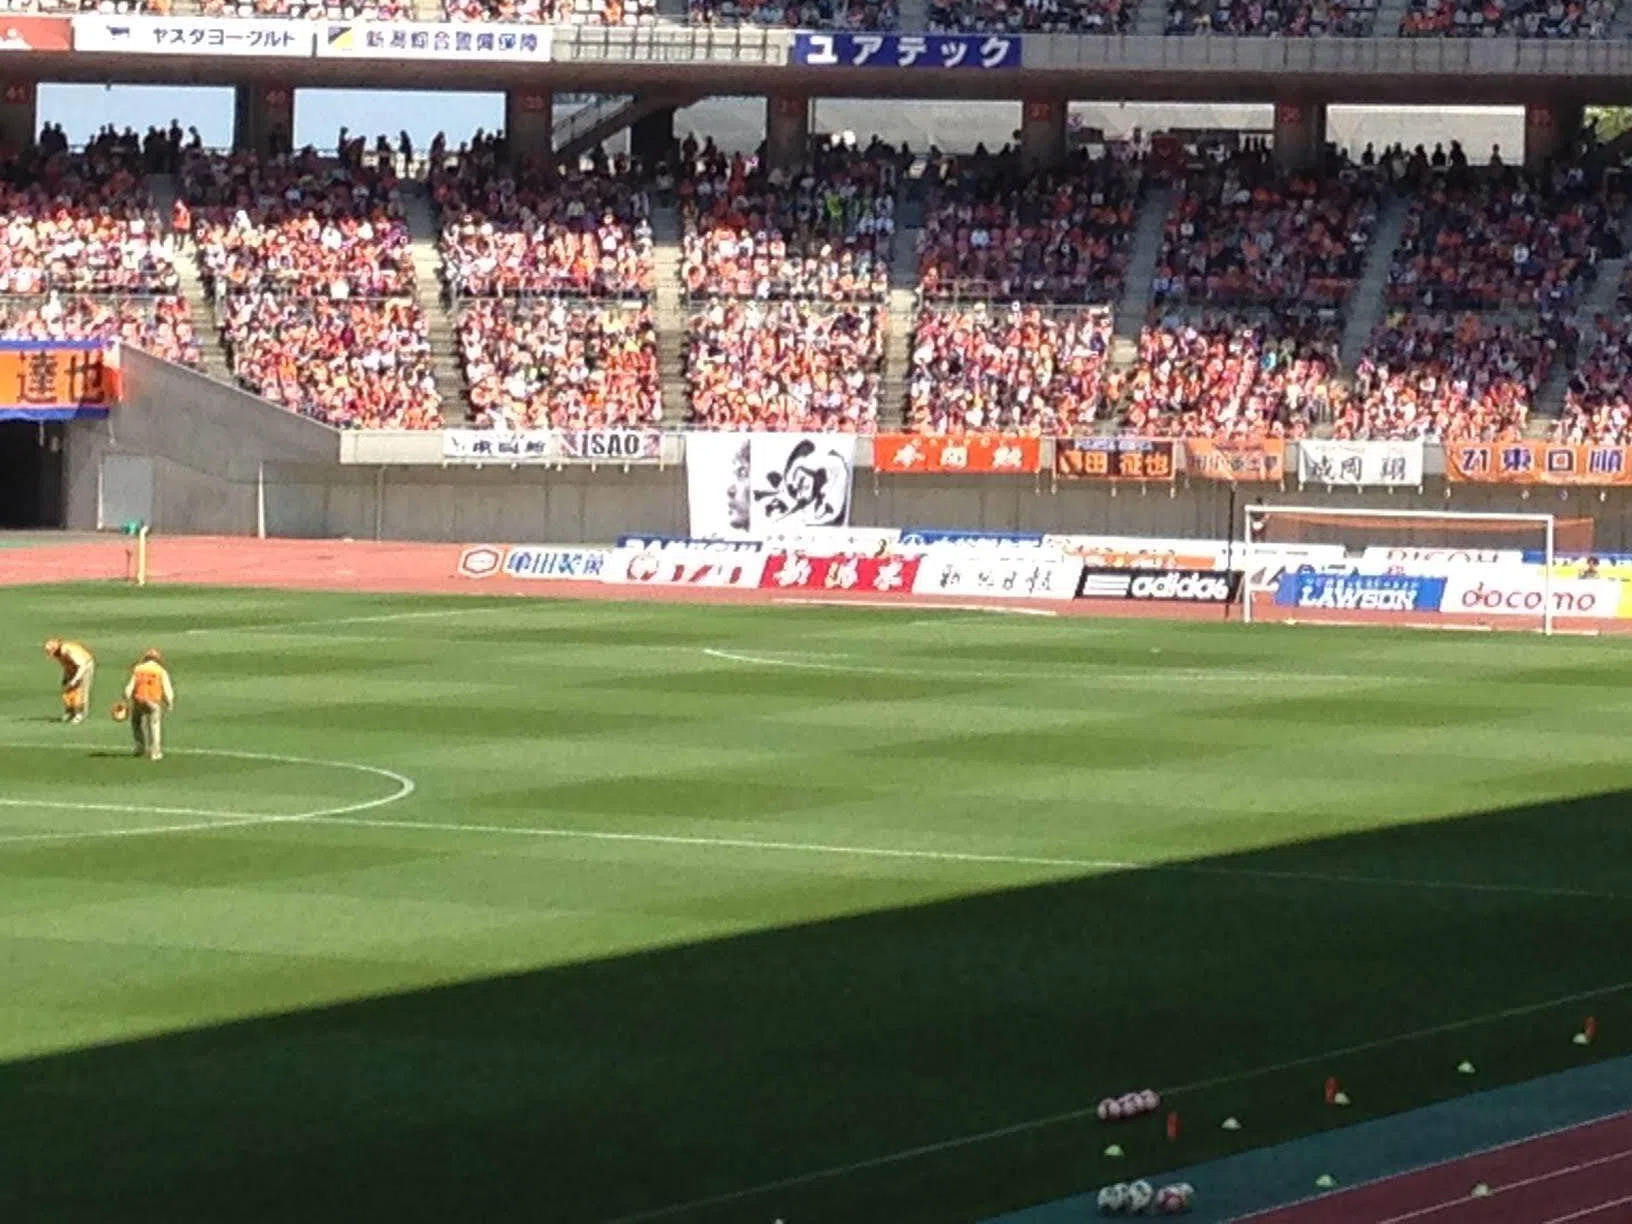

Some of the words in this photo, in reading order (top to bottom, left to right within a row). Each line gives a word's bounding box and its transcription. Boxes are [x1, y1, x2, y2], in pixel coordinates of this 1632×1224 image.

[806, 35, 1012, 67] ユアテック
[582, 433, 640, 456] ISAO
[1131, 573, 1230, 599] adidas
[1299, 586, 1417, 611] LAWSON
[1462, 582, 1596, 610] docomo
